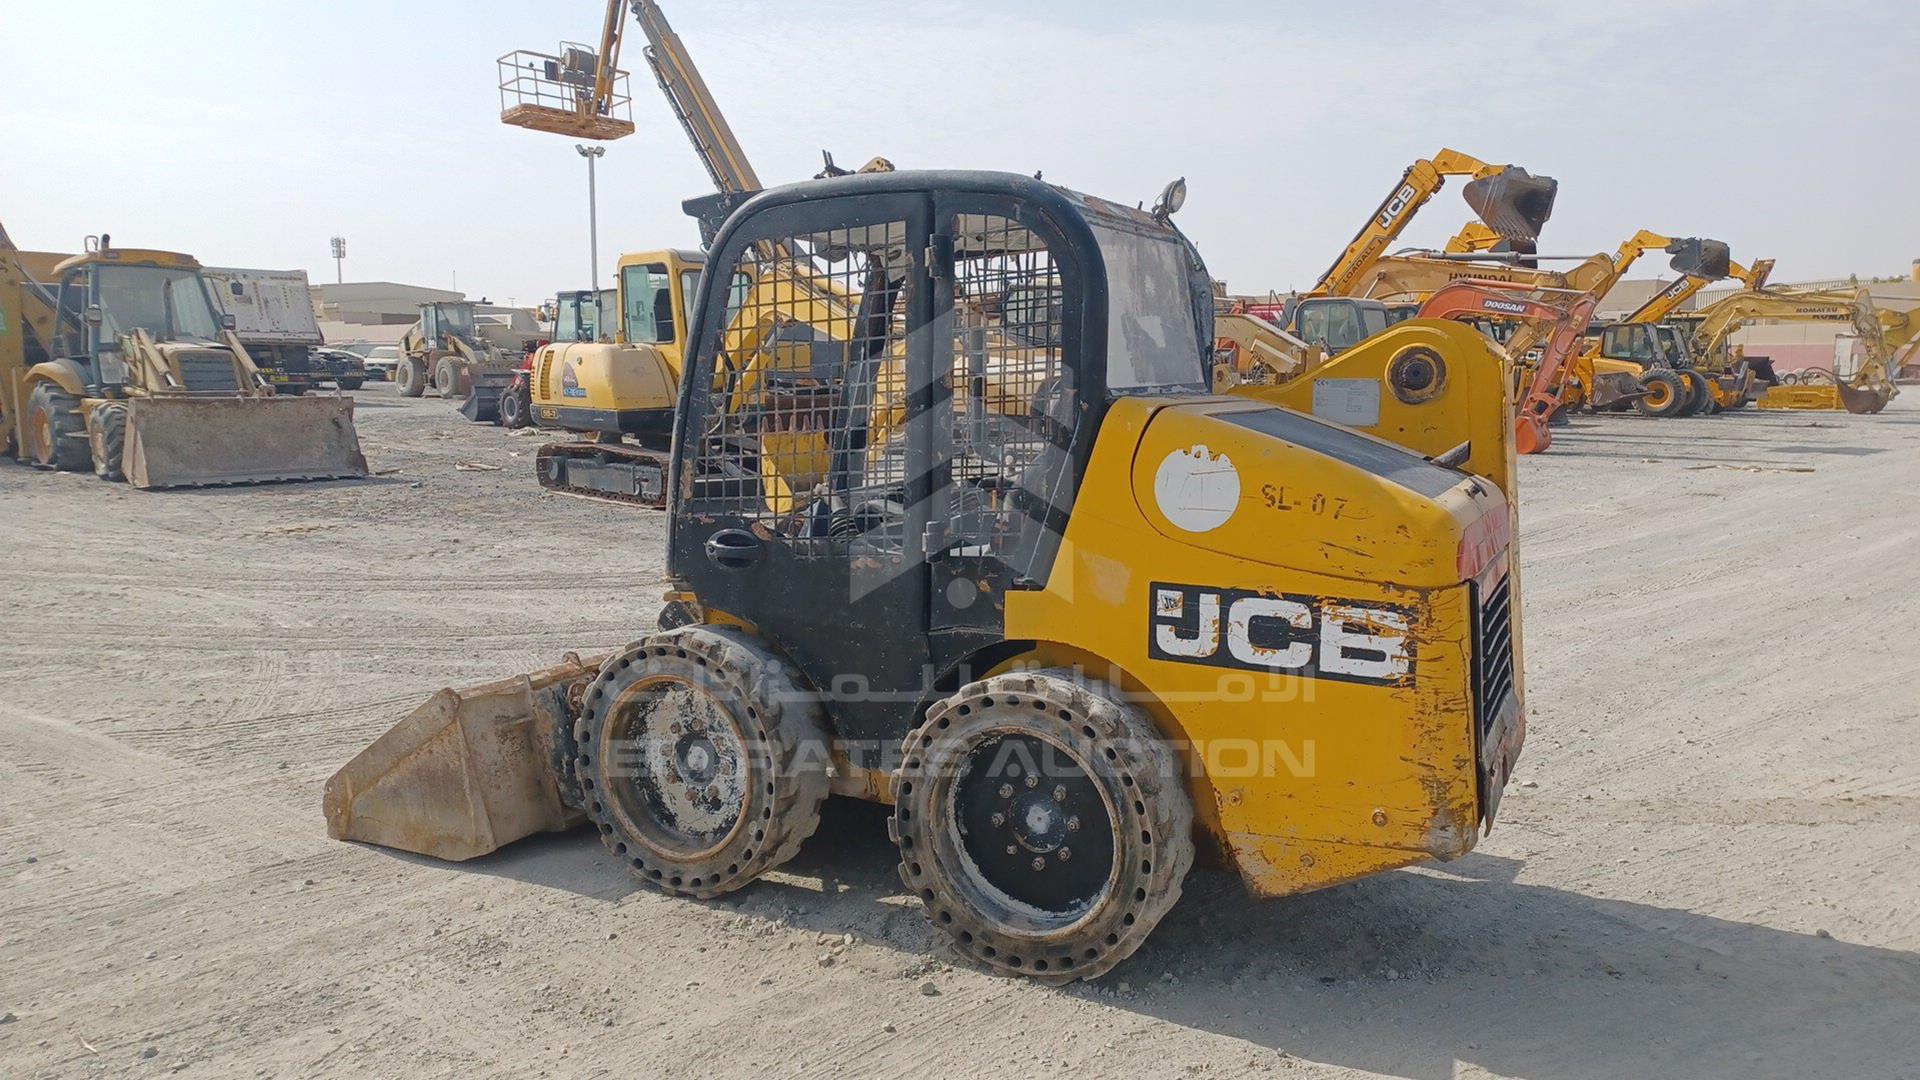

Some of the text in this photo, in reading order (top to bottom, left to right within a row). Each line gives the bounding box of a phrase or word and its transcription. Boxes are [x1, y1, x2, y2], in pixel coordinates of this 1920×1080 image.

[1378, 184, 1416, 229] JCB
[1342, 245, 1376, 283] LOADALL
[1484, 300, 1526, 313] DOOSAN
[1667, 279, 1690, 300] JCB
[1155, 588, 1410, 679] JCB
